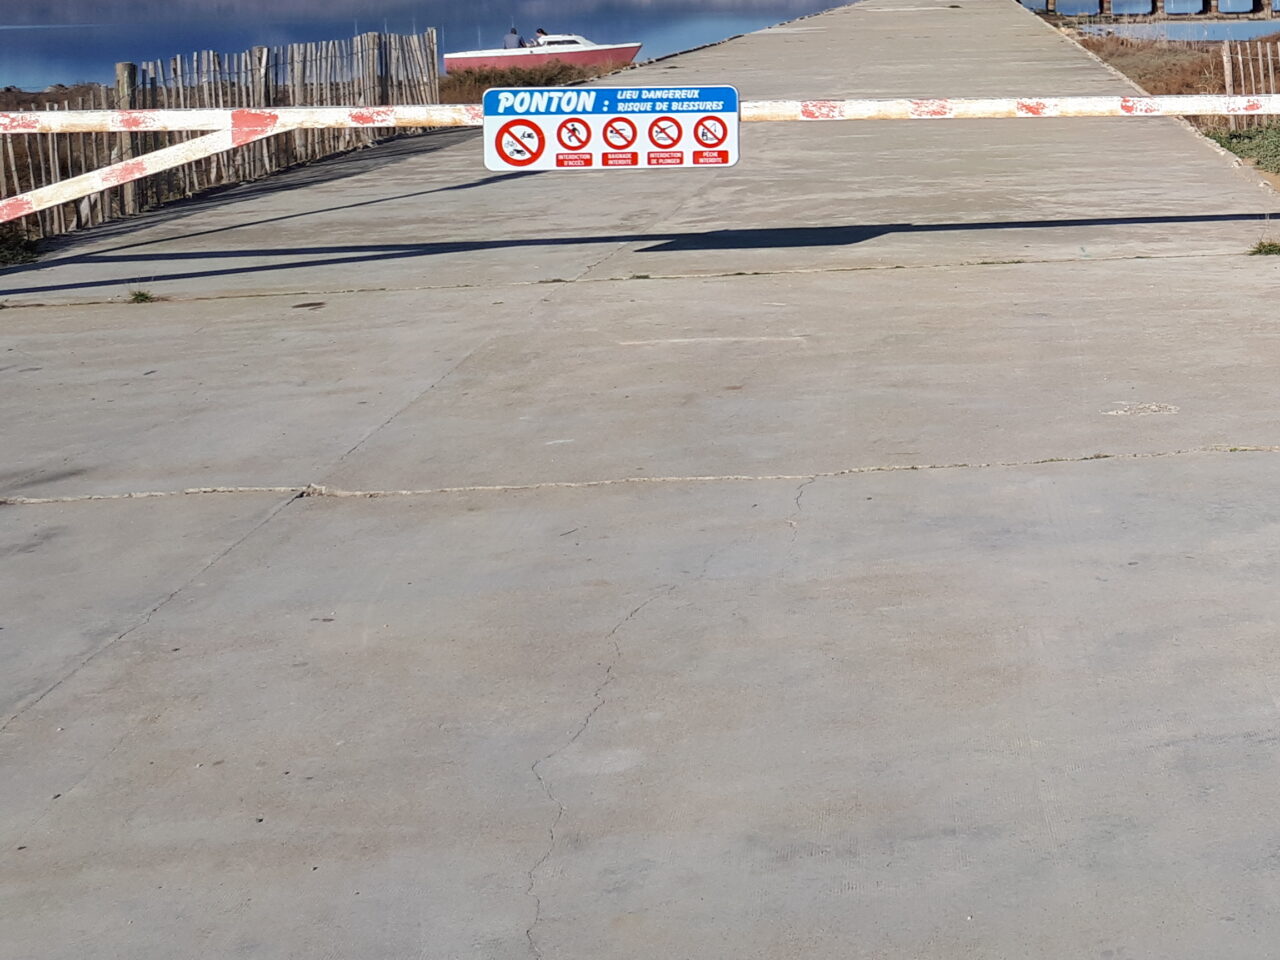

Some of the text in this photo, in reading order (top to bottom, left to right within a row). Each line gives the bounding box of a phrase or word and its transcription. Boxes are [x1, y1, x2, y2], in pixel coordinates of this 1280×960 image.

[617, 89, 700, 100] LIEU DANGEREUX
[497, 90, 596, 114] PONTON
[617, 100, 724, 112] RISQUE DE BLESSURES
